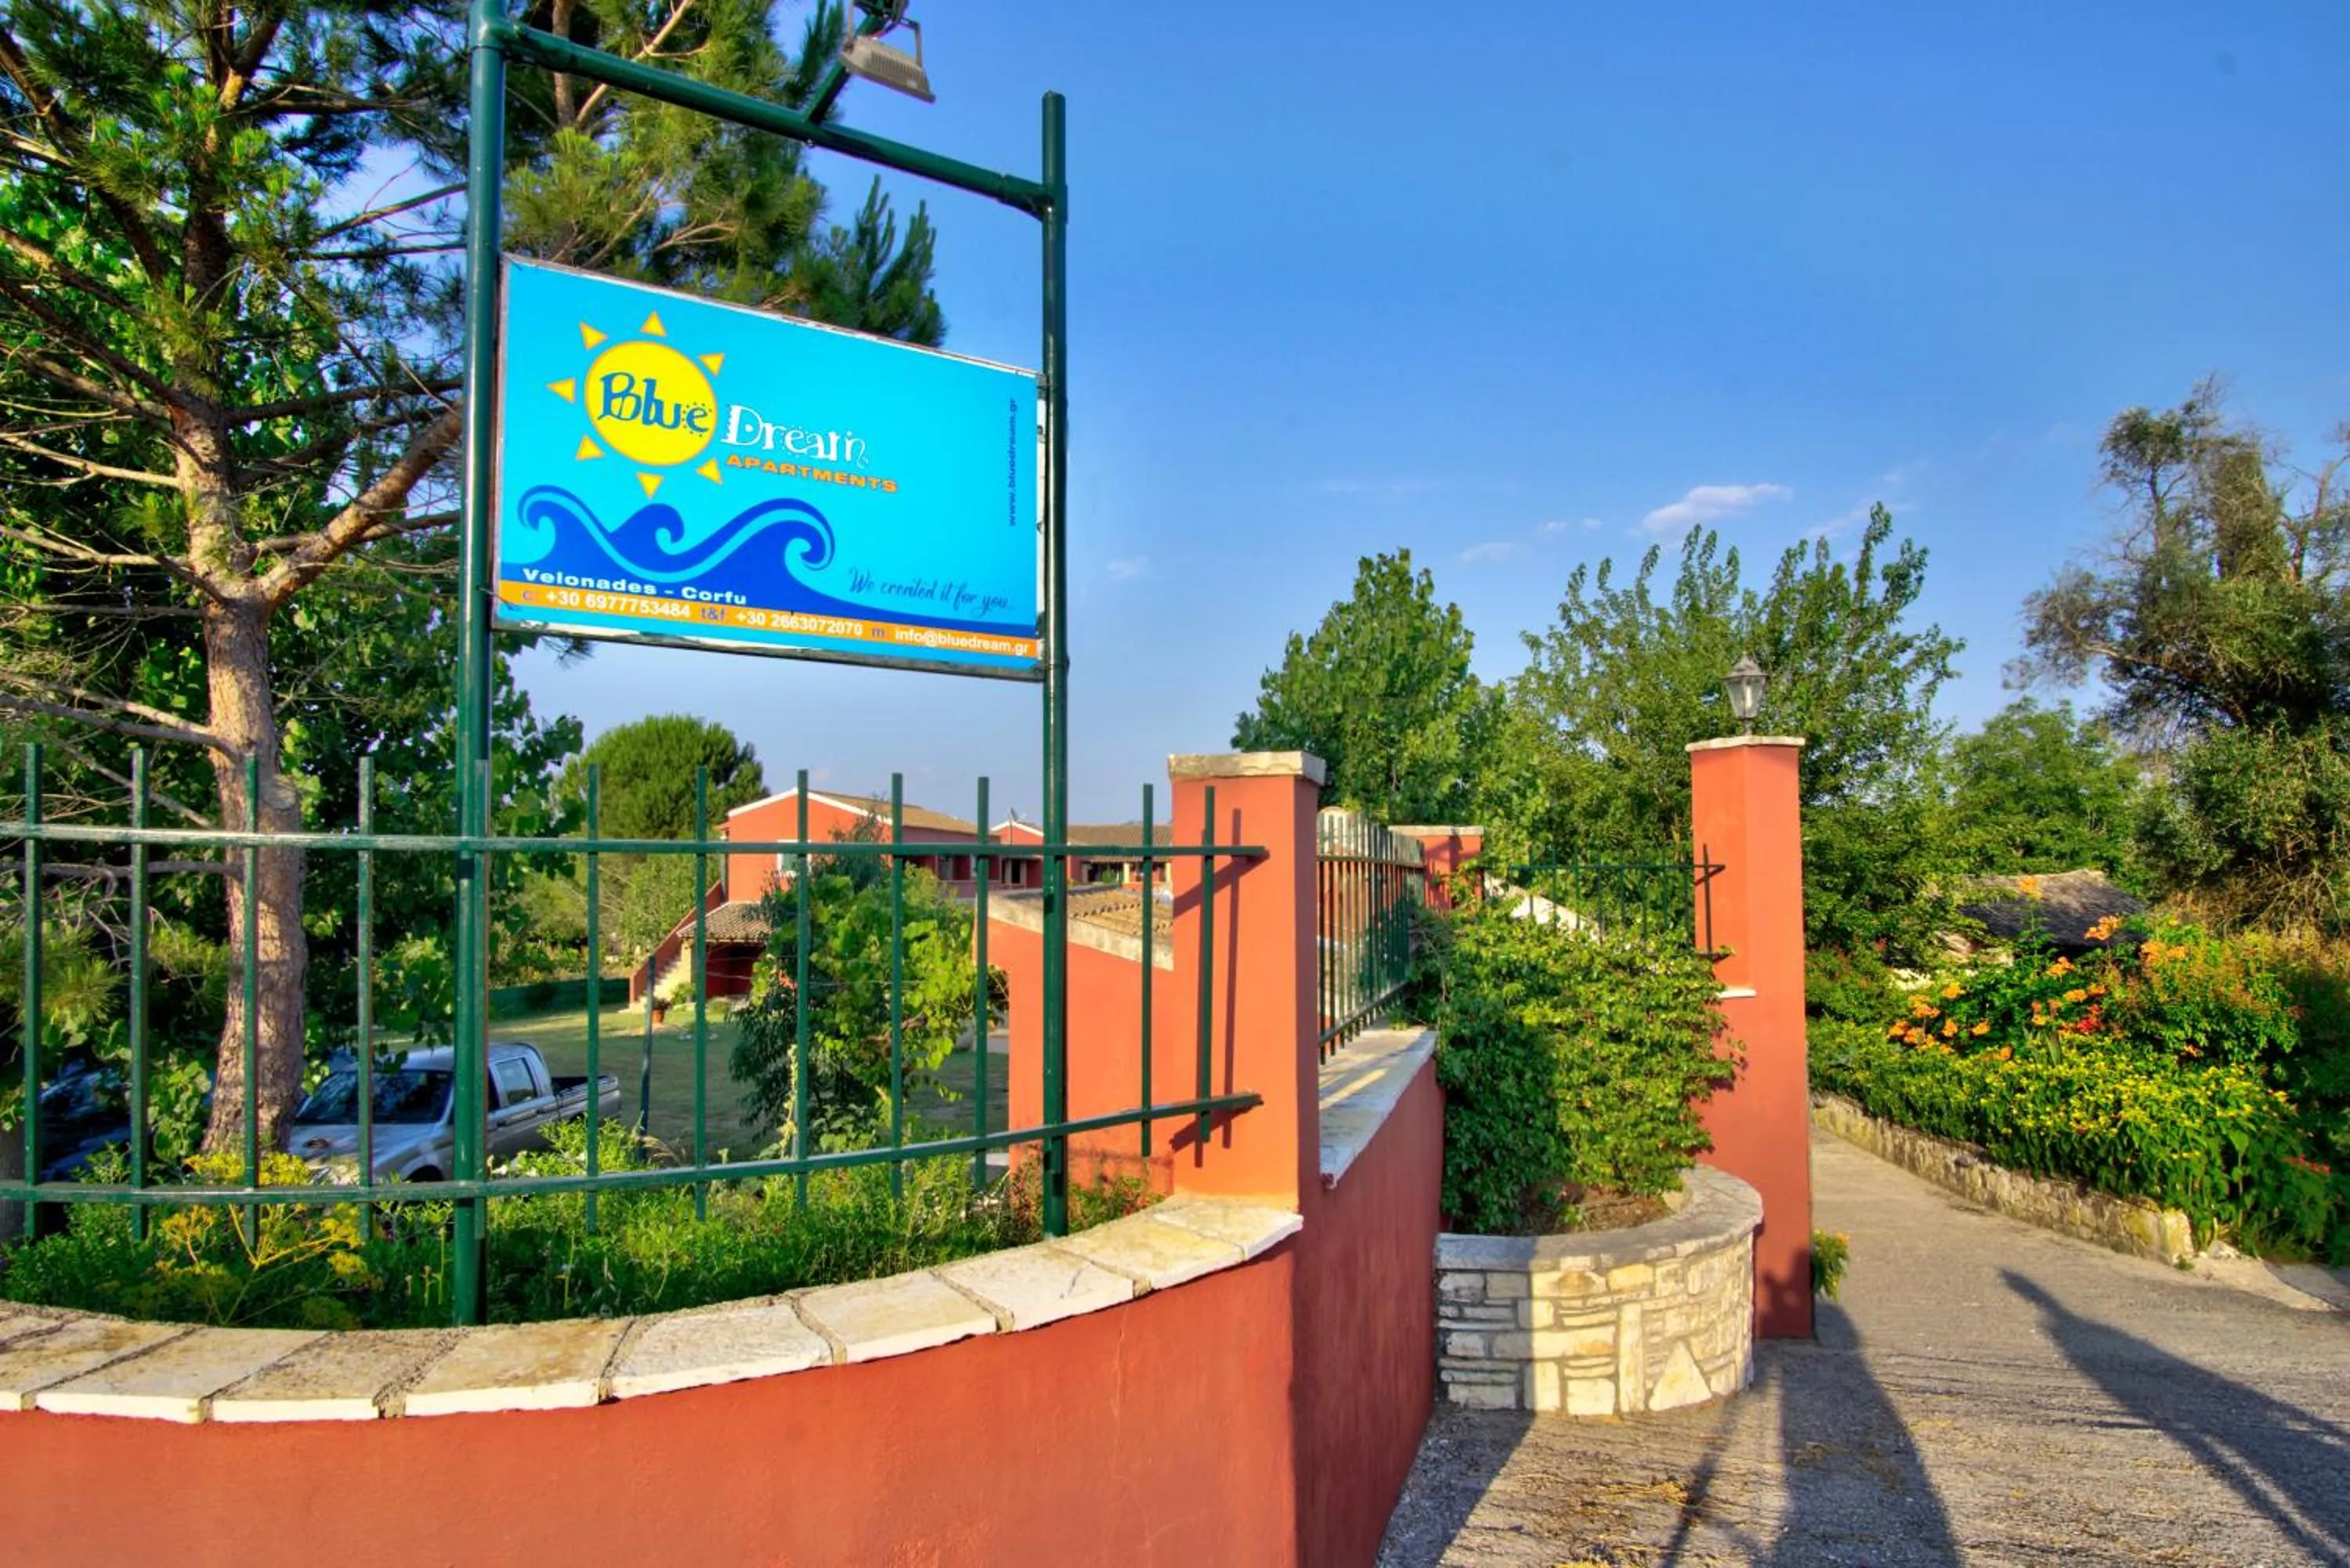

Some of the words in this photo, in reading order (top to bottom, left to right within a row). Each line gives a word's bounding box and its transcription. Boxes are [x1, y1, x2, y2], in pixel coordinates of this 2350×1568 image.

[597, 371, 711, 438] Blue
[720, 403, 870, 469] Dream
[725, 453, 899, 493] APARTMENTS
[1008, 396, 1018, 526] www.bluedream.gr
[522, 567, 657, 595] Velonades
[682, 586, 747, 605] Corfu
[848, 567, 874, 594] We
[880, 578, 938, 601] created
[940, 581, 953, 602] it
[953, 583, 978, 612] for
[546, 590, 580, 606] +30
[585, 593, 691, 617] 6977753484
[736, 611, 765, 626] +30
[895, 628, 1030, 656] info@bluedream.gr
